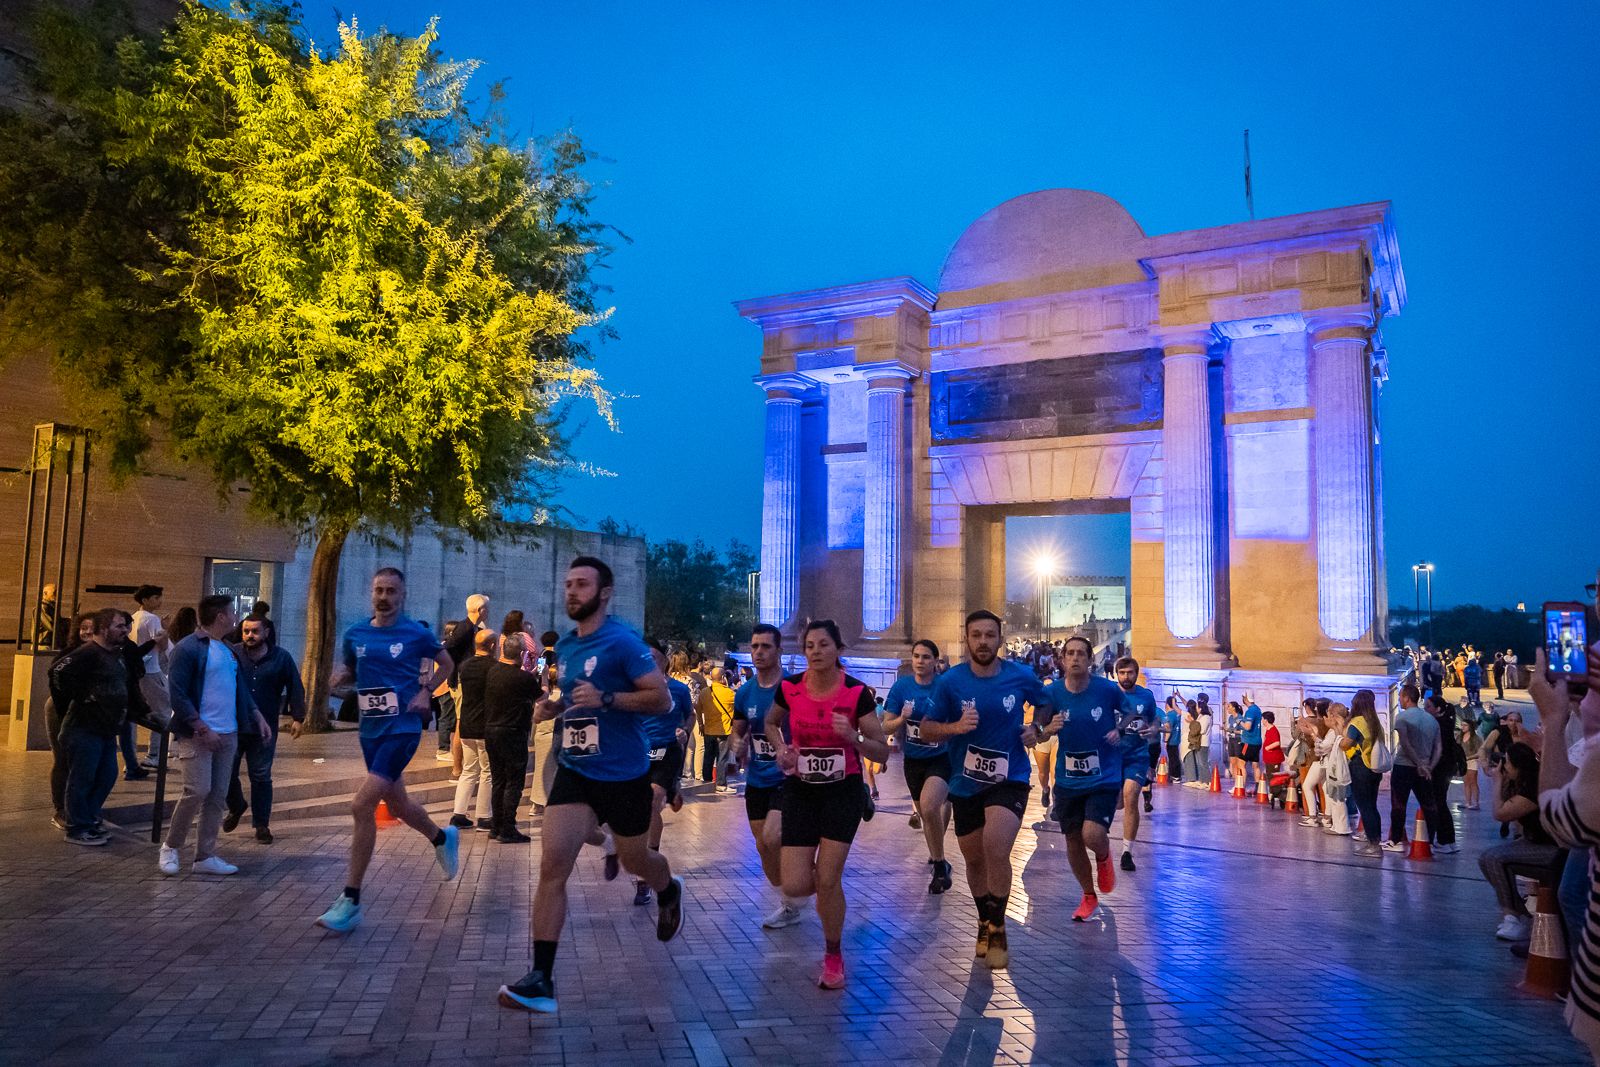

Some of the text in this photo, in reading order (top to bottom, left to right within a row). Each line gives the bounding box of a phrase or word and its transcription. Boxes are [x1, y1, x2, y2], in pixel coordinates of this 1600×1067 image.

[368, 695, 387, 708] 534
[570, 730, 586, 745] 319
[806, 758, 836, 772] 1307
[975, 757, 997, 773] 356
[1073, 759, 1090, 770] 451
